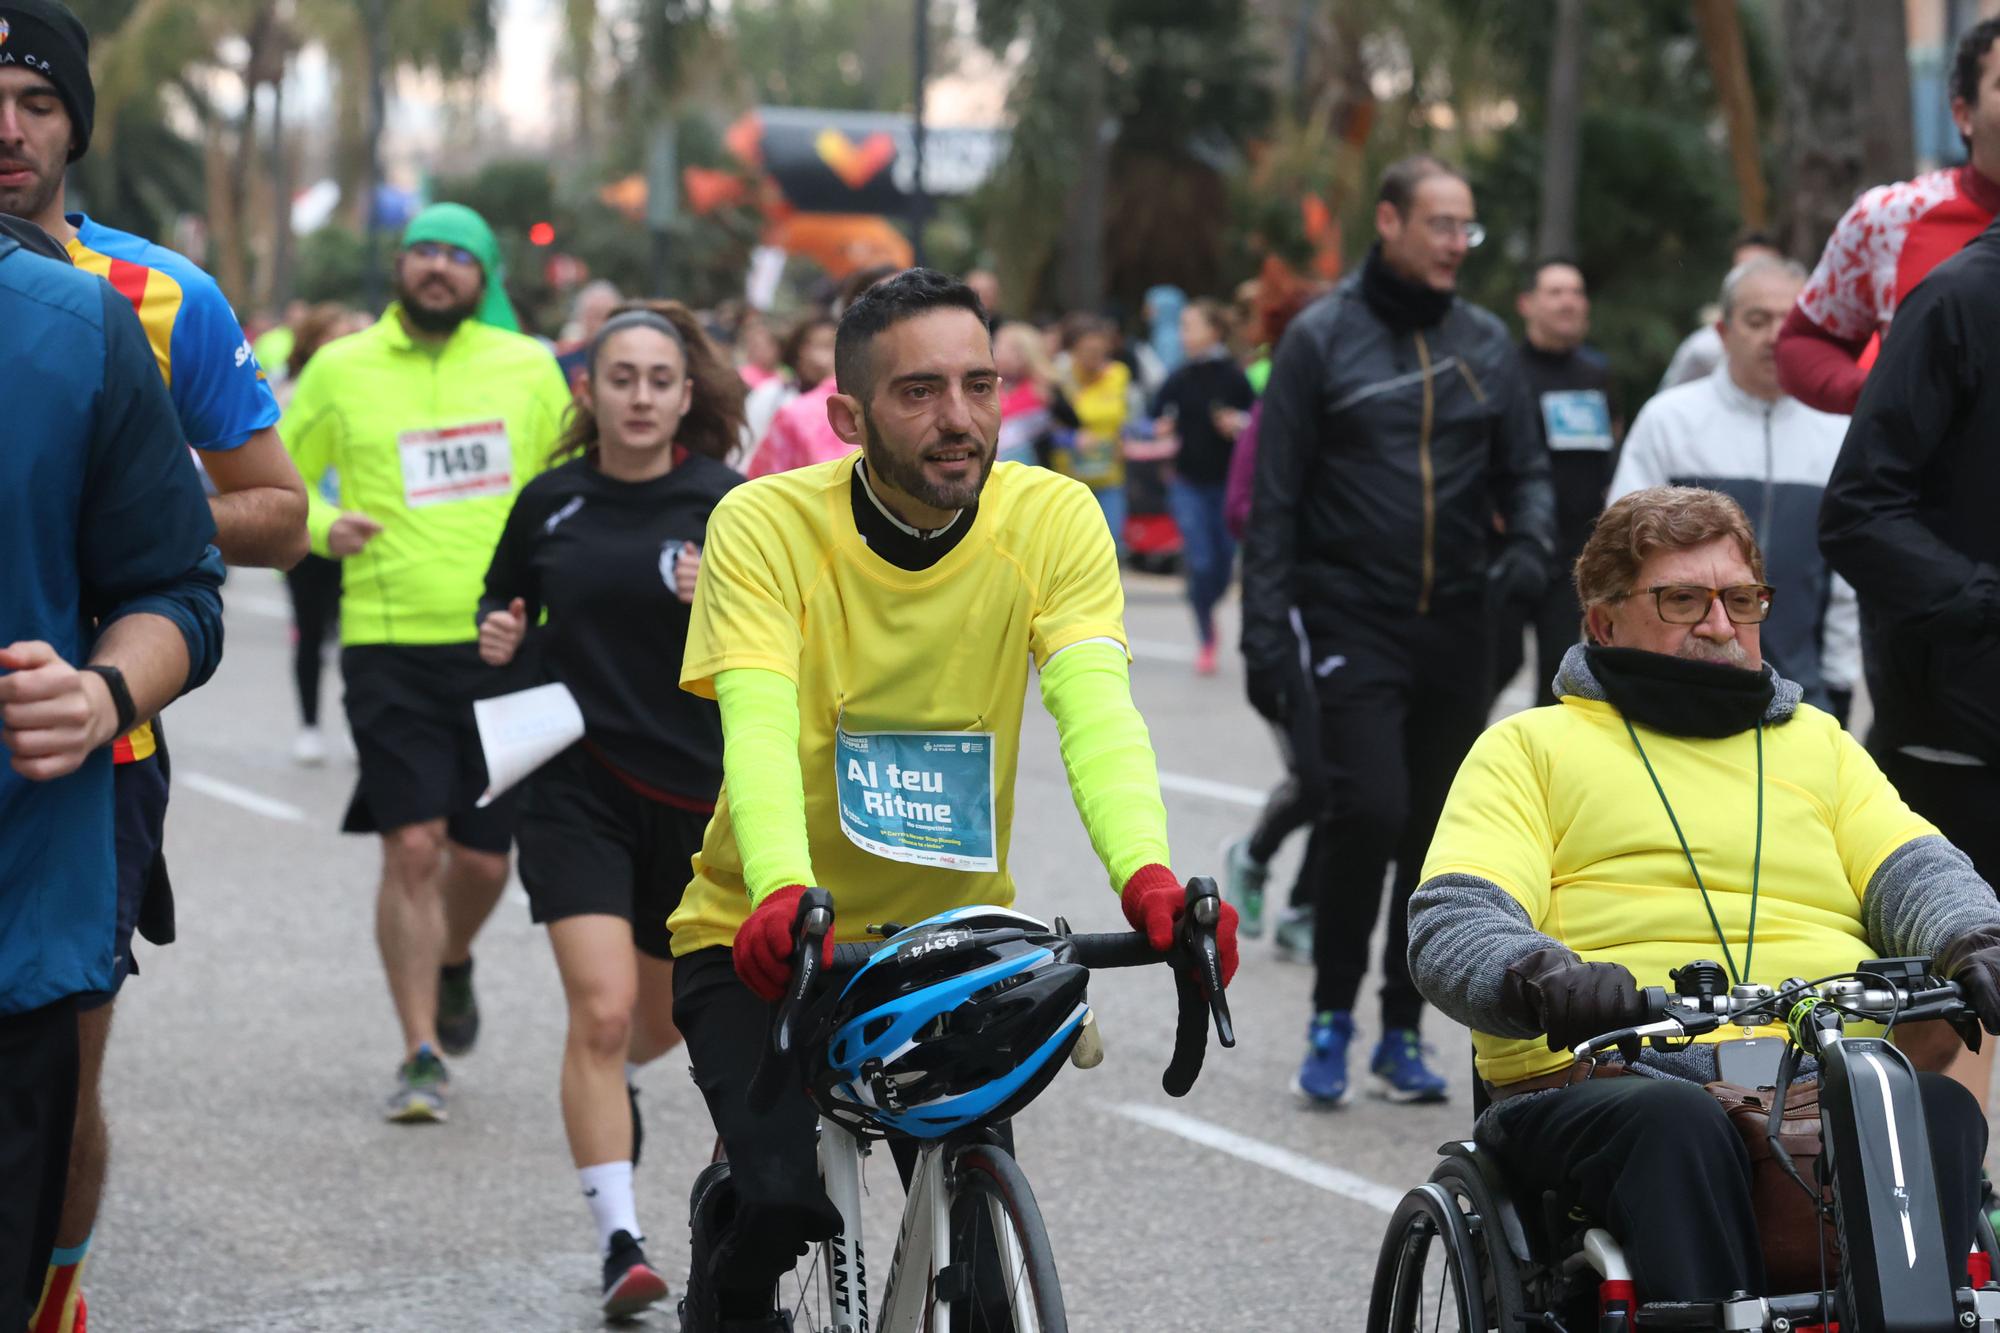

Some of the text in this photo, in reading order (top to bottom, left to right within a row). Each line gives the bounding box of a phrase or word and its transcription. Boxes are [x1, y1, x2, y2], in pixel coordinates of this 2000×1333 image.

[426, 443, 487, 478] 7149
[847, 758, 943, 793] Al teu
[863, 790, 952, 824] Ritme
[910, 934, 959, 958] 9314
[1206, 948, 1219, 991] ULTEGRA
[832, 1235, 850, 1315] IANT
